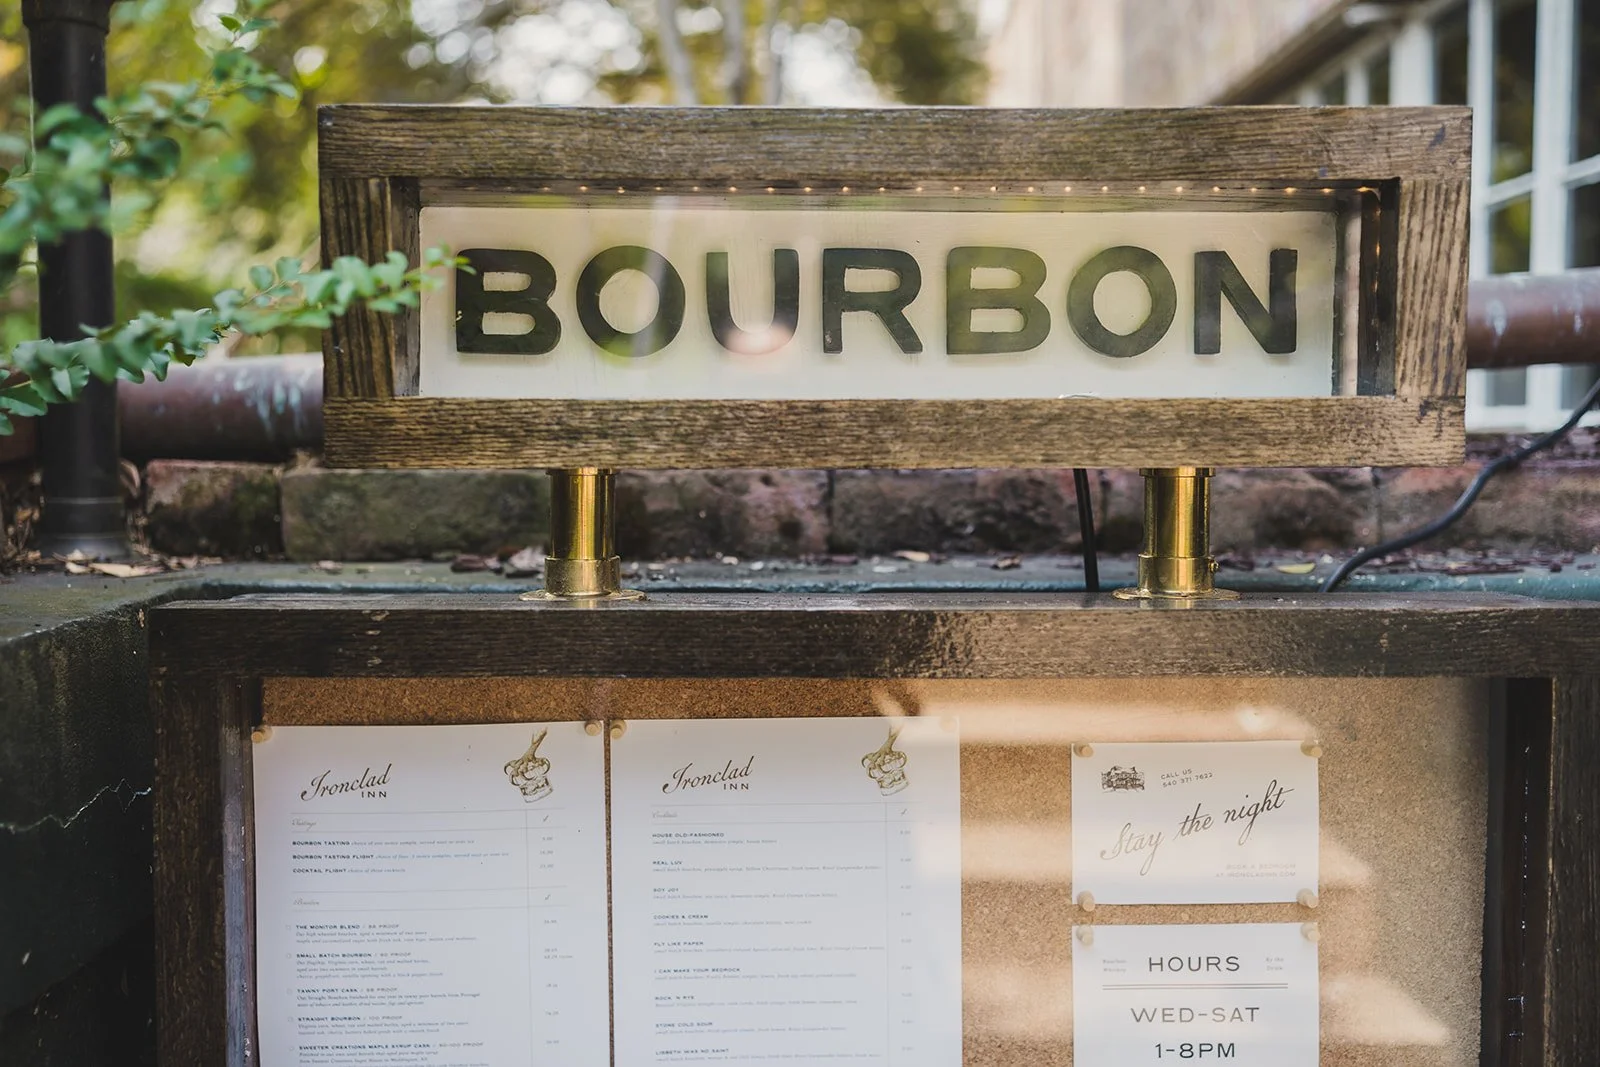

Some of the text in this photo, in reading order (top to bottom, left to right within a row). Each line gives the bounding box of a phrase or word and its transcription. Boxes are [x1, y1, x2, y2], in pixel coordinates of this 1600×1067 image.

[454, 243, 1299, 358] BOURBON
[300, 763, 392, 801] Ironclad
[662, 755, 754, 794] Ironclad
[1160, 768, 1192, 780] CALL US
[361, 790, 387, 799] INN
[723, 783, 750, 791] INN
[1100, 779, 1295, 876] Stay the night
[1148, 956, 1240, 972] HOURS
[1130, 1007, 1260, 1023] WED-SAT
[1154, 1042, 1236, 1058] 1-8PM
